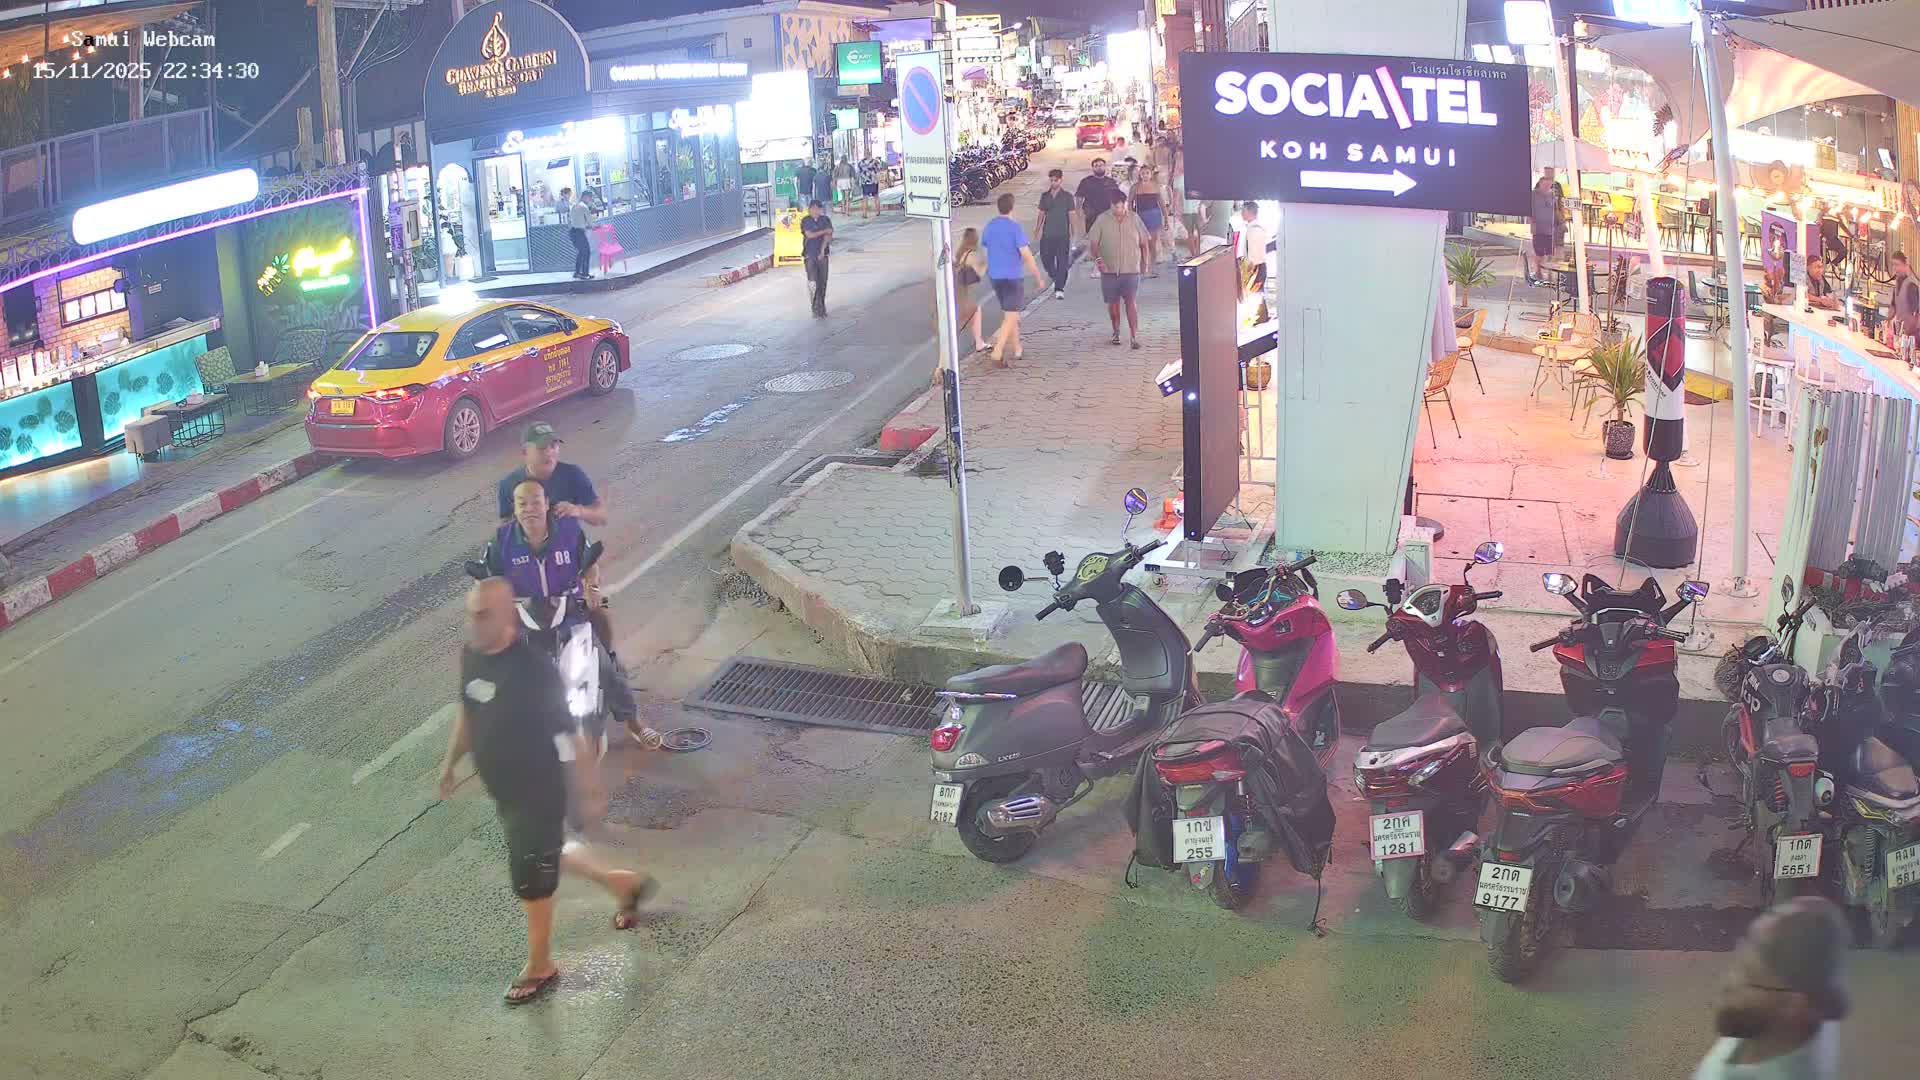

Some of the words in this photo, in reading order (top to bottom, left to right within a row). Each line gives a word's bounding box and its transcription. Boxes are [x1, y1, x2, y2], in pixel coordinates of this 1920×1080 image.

[1410, 61, 1507, 79] โรงแรมโซเชียลเทล
[1260, 140, 1328, 161] KOH
[1346, 142, 1457, 167] SAMUI
[910, 176, 918, 184] NO
[919, 176, 942, 185] PARKING
[934, 810, 953, 822] 2187
[1187, 847, 1213, 860] 255
[1381, 841, 1414, 856] 1281
[1781, 863, 1811, 875] 5651
[1482, 892, 1520, 909] 9177
